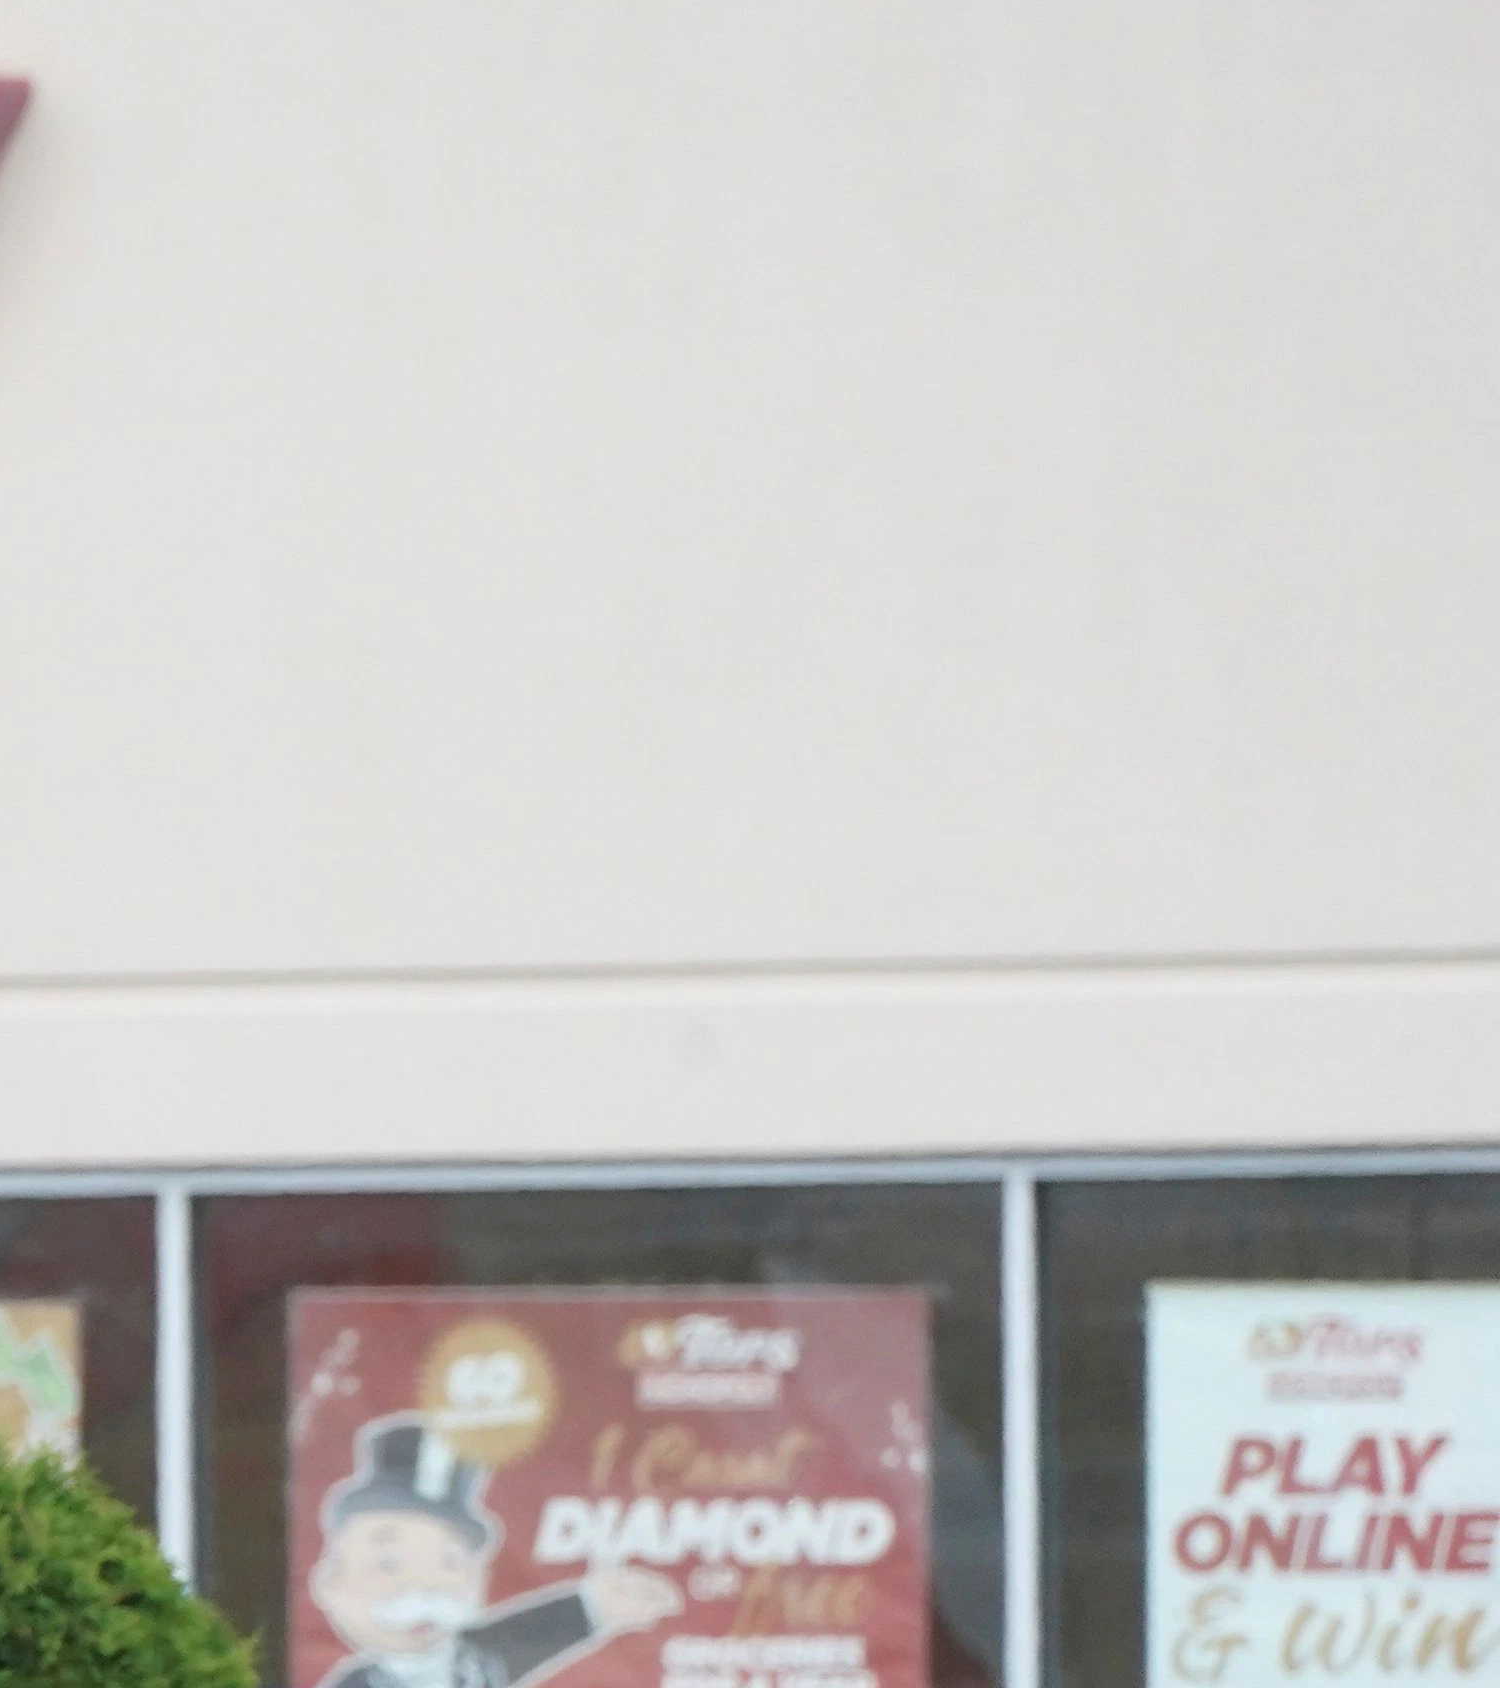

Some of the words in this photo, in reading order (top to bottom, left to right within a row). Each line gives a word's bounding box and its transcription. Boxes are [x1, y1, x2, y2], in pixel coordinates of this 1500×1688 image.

[1221, 1434, 1447, 1497] PLAY
[533, 1494, 896, 1565] DIAMOND
[1175, 1512, 1500, 1574] ONLINE
[1171, 1584, 1248, 1688] &
